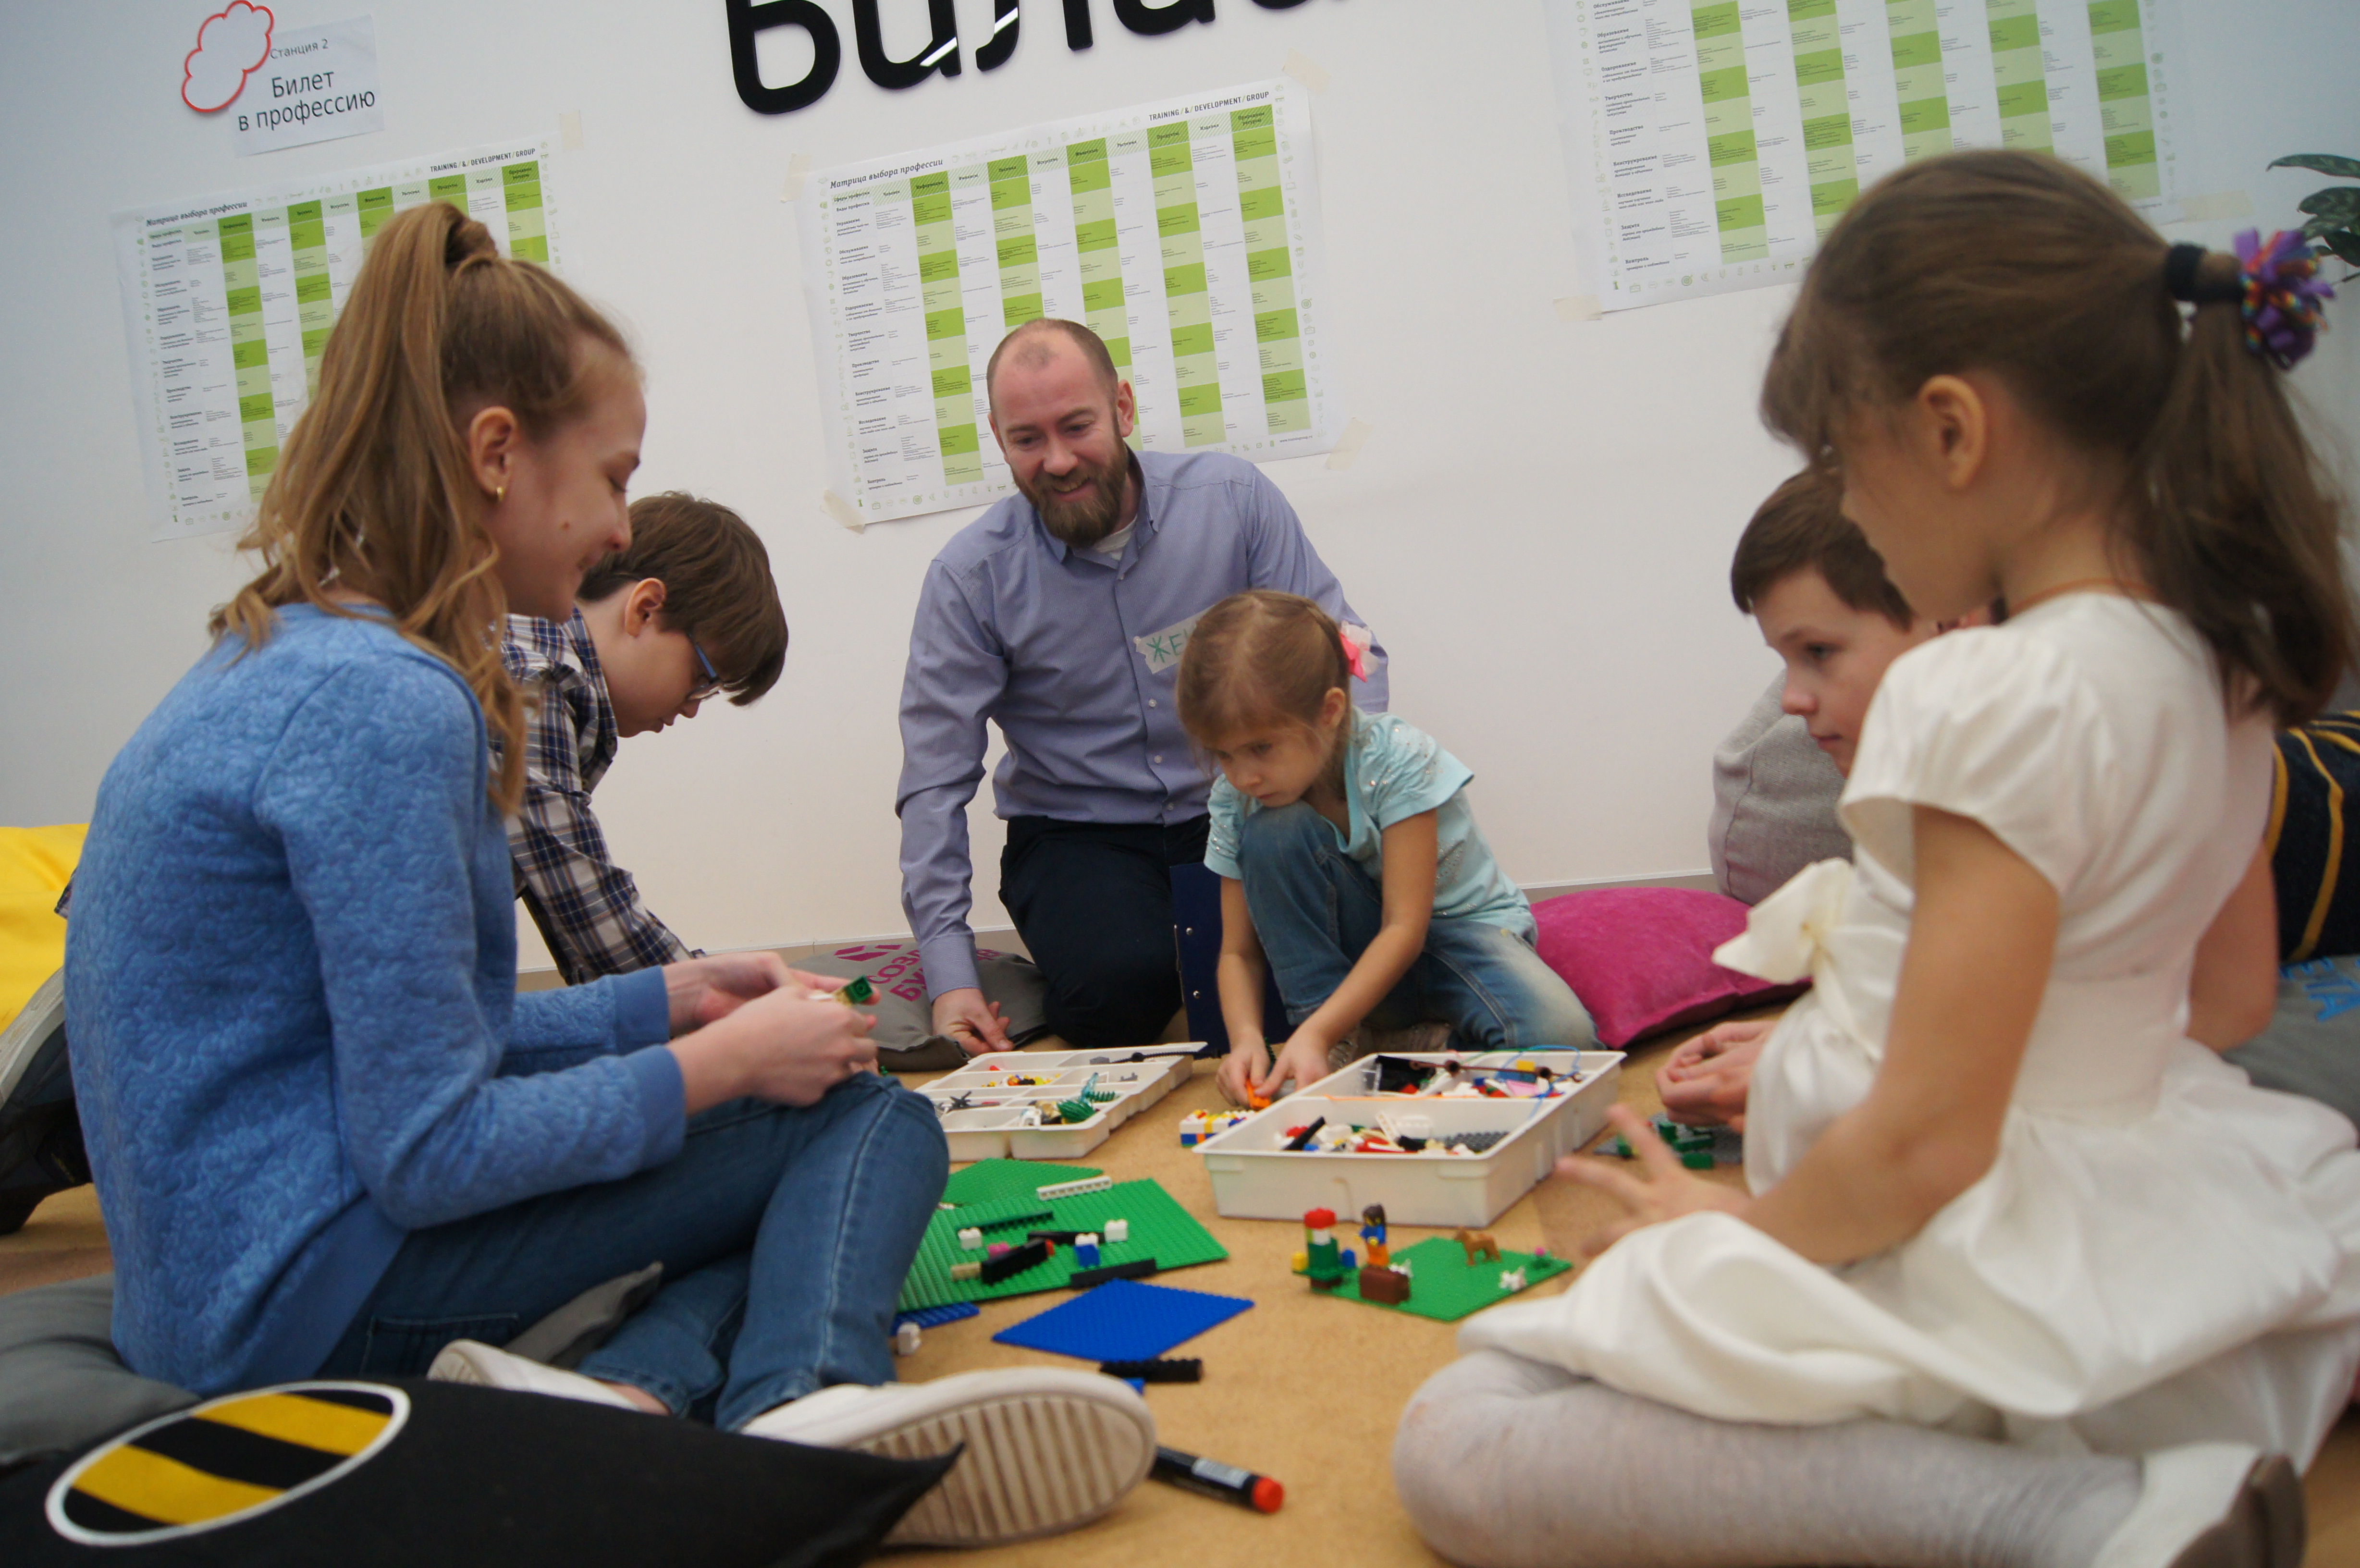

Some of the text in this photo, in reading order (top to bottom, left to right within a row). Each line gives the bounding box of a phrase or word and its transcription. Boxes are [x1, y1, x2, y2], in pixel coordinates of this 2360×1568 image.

[1597, 28, 1629, 38] Образование
[270, 38, 329, 60] Станция 2
[1601, 61, 1636, 72] Оздоровление
[271, 71, 335, 98] Билет
[1605, 92, 1633, 101] Творчество
[238, 90, 376, 131] в профессию
[1610, 125, 1644, 135] Производство
[1613, 155, 1657, 166] Конструирование
[830, 159, 943, 189] Матрица выбора профессии
[1617, 189, 1652, 198] Исследование
[209, 202, 247, 215] профессии
[839, 245, 869, 254] Обслуживание
[852, 360, 880, 368] Производство
[855, 387, 891, 396] Конструирование
[858, 416, 886, 425] Исследование
